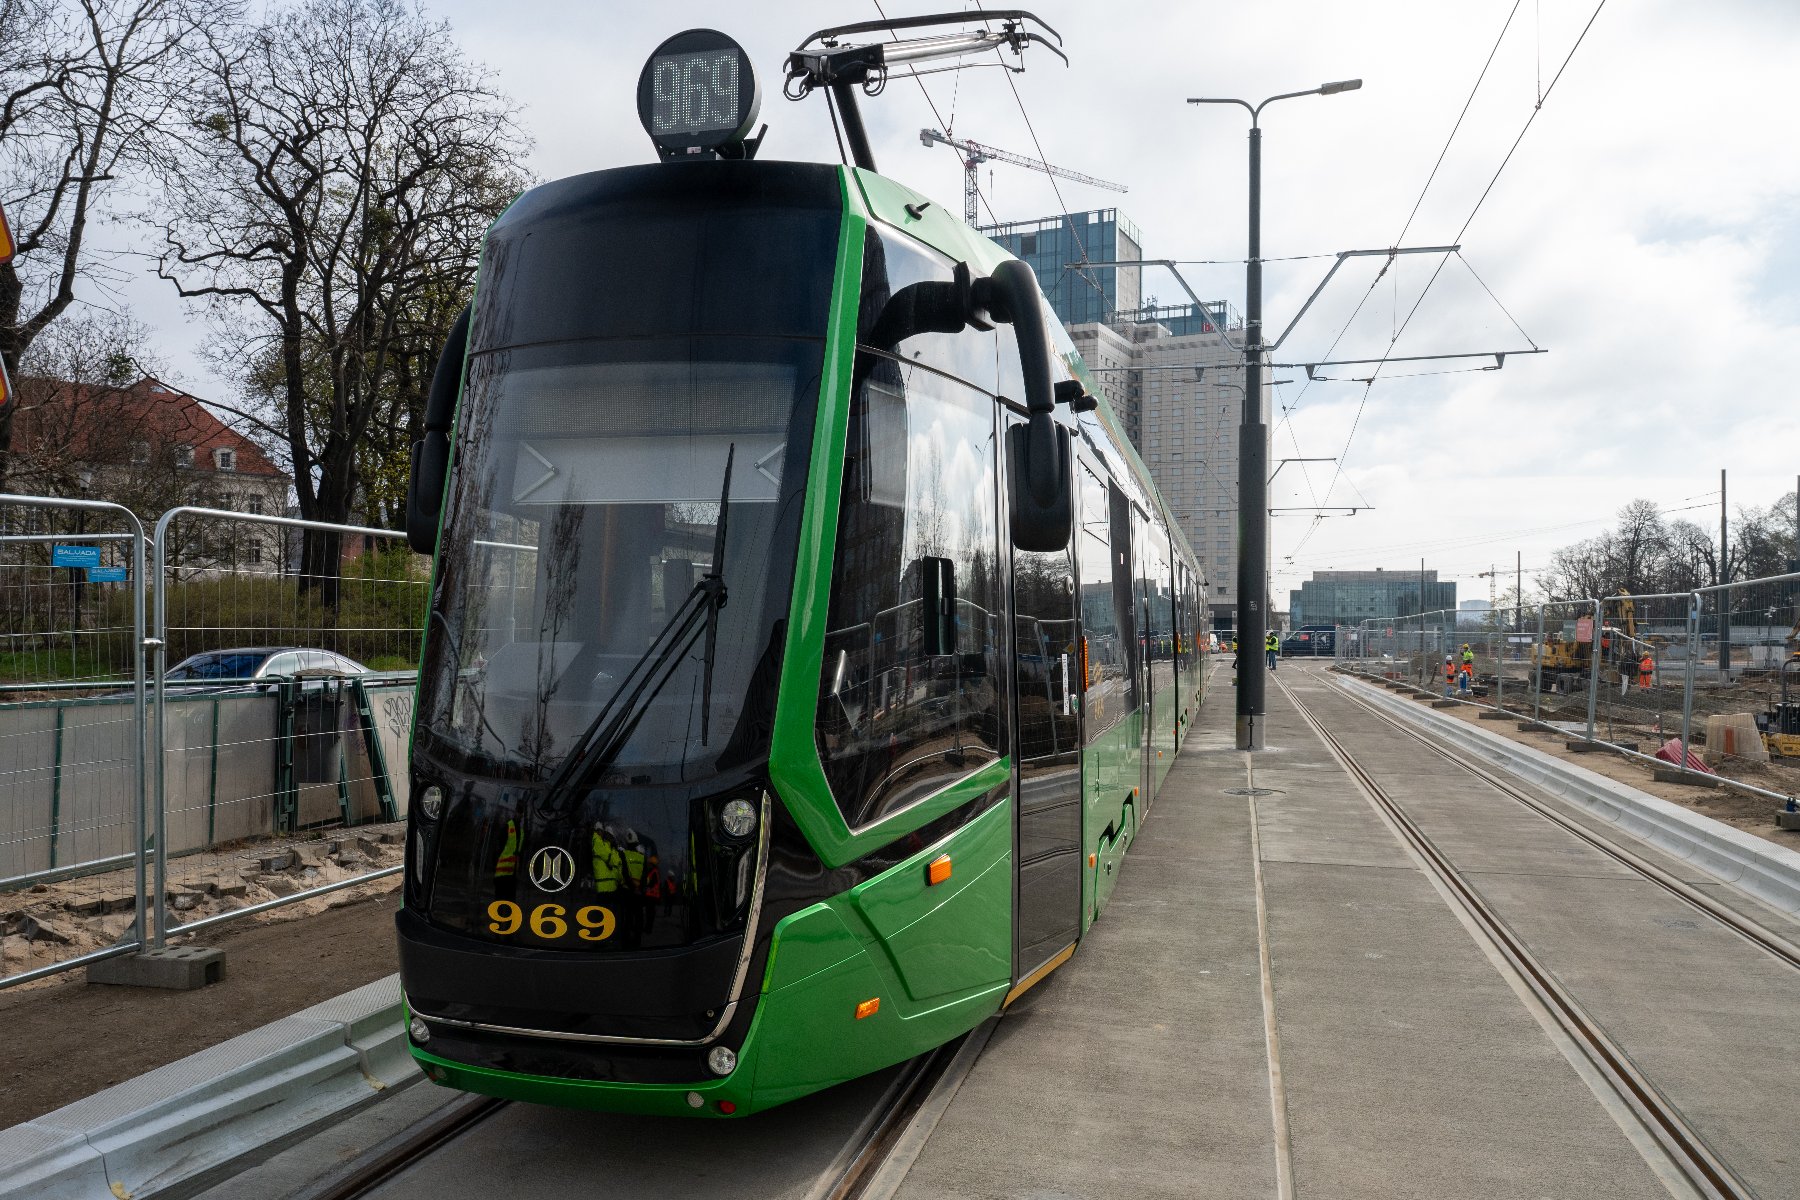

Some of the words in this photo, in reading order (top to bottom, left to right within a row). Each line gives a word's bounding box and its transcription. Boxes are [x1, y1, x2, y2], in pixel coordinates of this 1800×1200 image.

[654, 55, 739, 129] 969
[57, 548, 97, 556] BALVADA
[487, 900, 616, 941] 969
